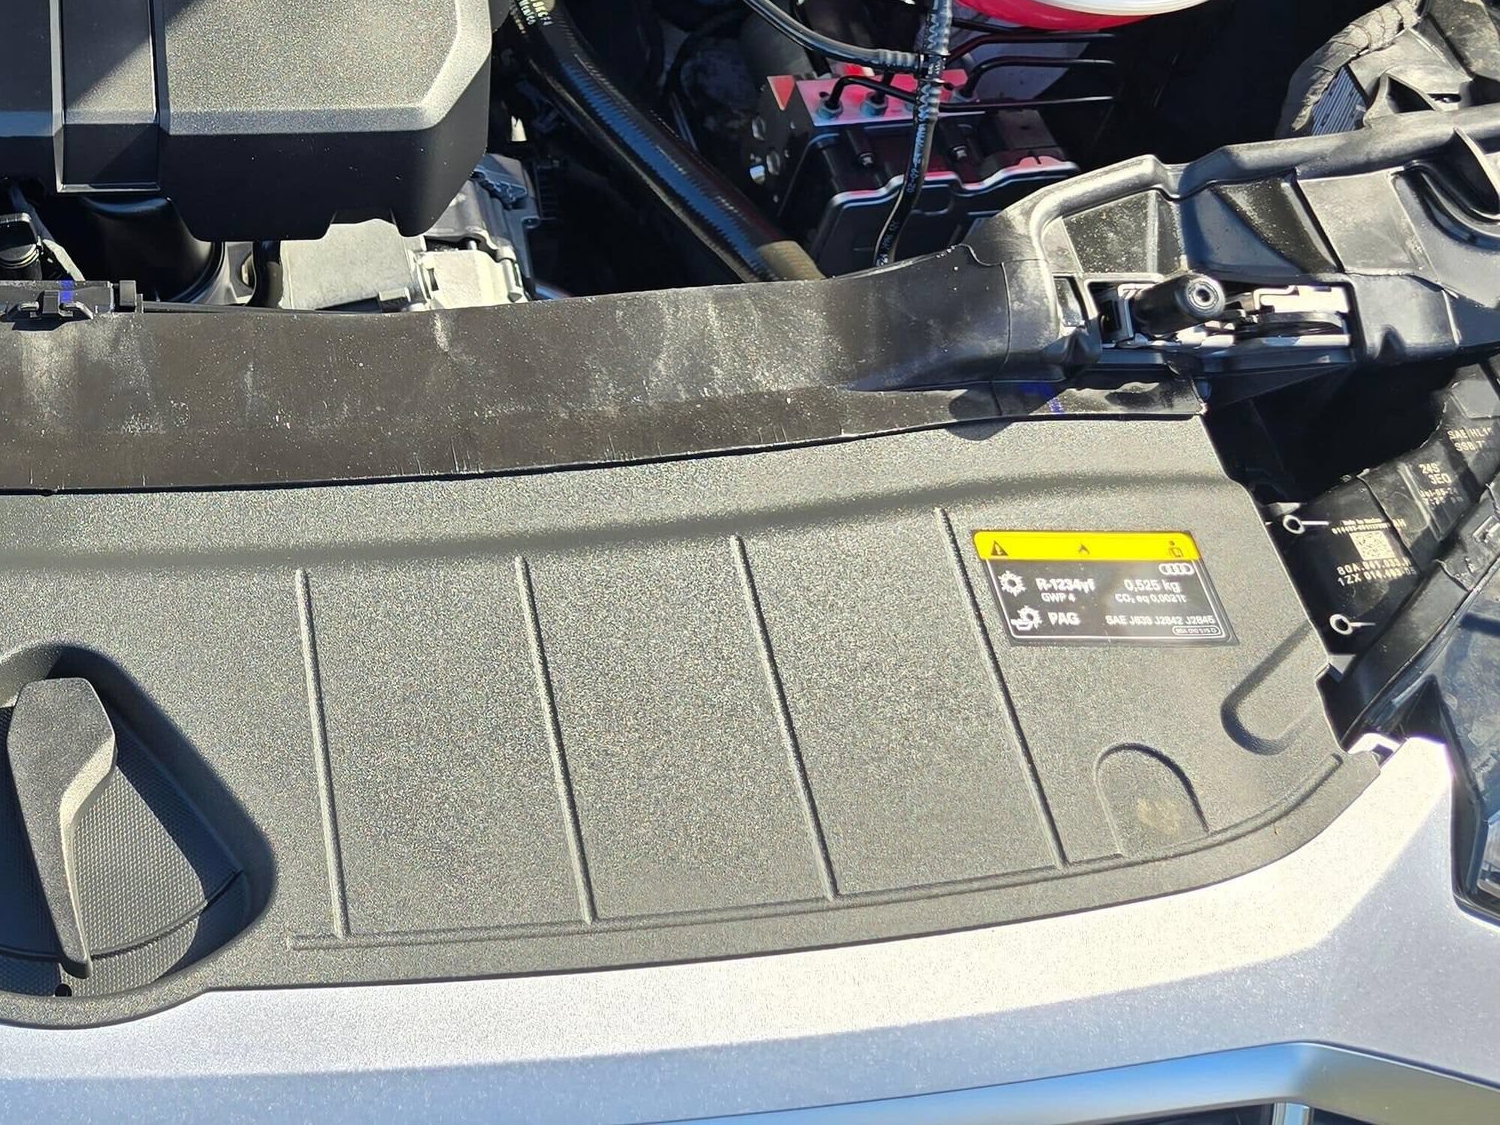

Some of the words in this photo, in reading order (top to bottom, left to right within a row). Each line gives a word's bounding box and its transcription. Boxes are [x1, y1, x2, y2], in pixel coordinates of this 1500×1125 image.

[1447, 429, 1468, 440] SAE
[1419, 462, 1441, 474] 24S
[1337, 573, 1362, 586] 1ZX
[1035, 578, 1096, 594] R-1234yf
[1123, 578, 1161, 592] 0,525
[1163, 579, 1182, 593] kg
[1041, 592, 1067, 602] GWP
[1067, 593, 1076, 603] 4
[1137, 595, 1149, 604] eq
[1150, 594, 1187, 604] 0,0021t
[1047, 611, 1081, 625] PAG
[1105, 615, 1128, 625] SAE
[1154, 615, 1184, 625] J2842
